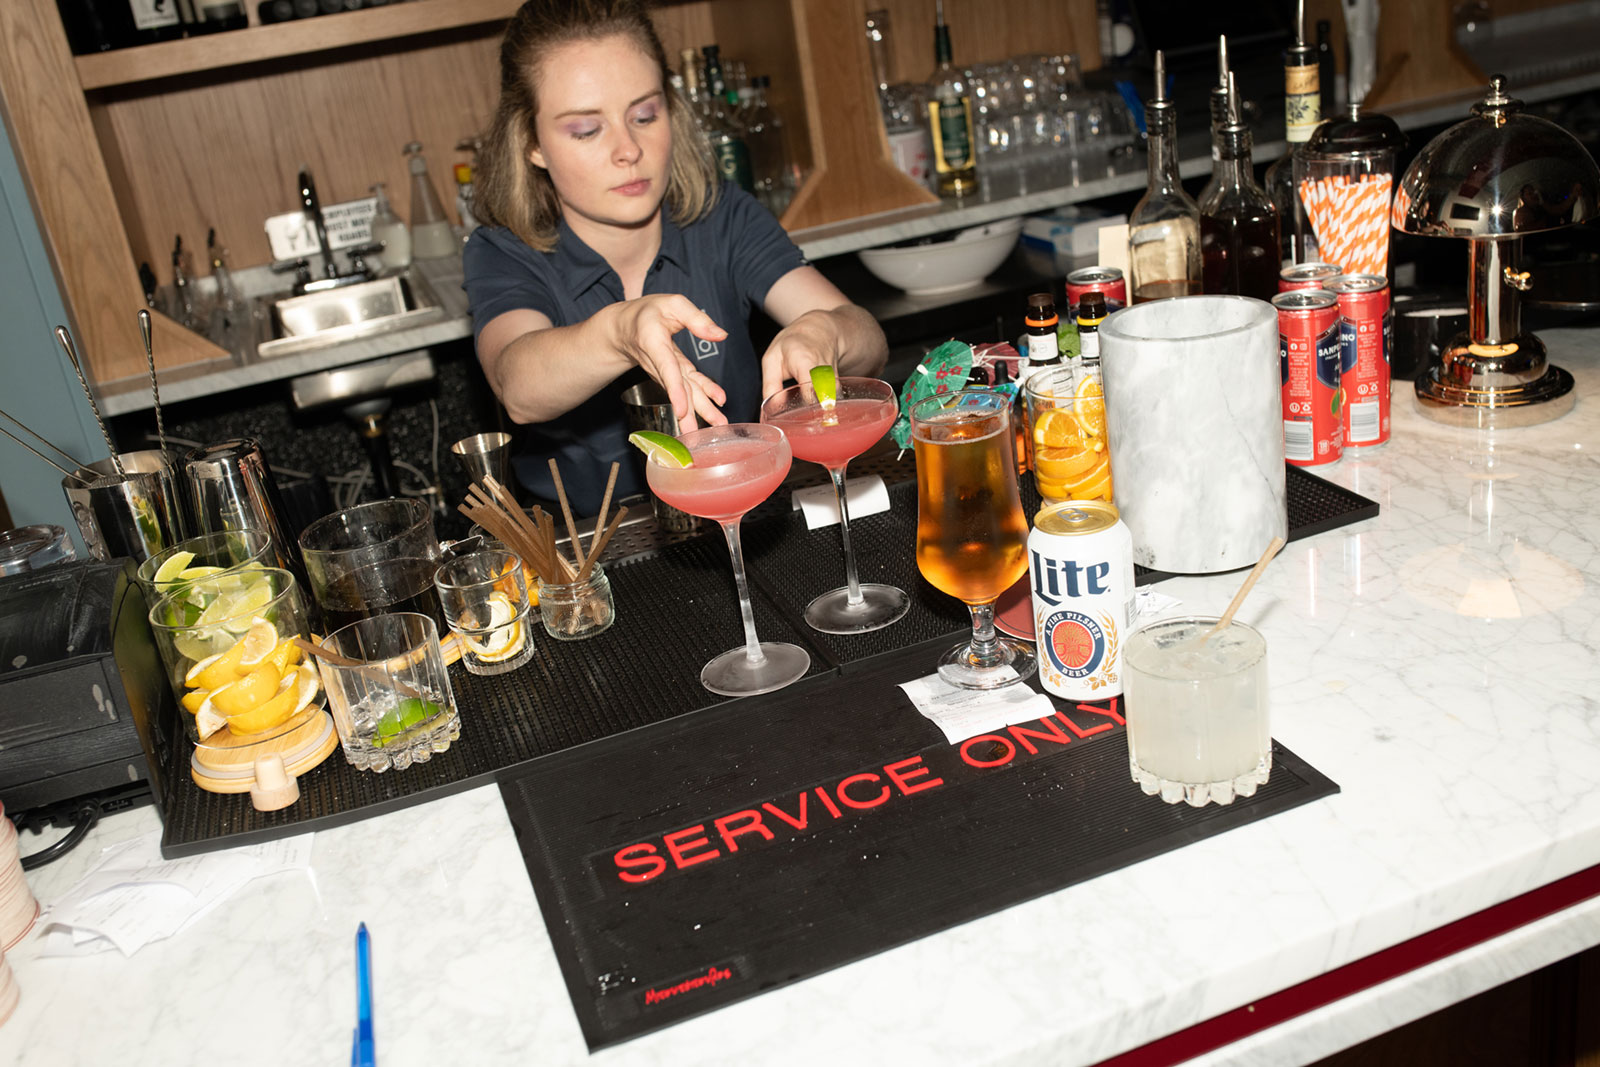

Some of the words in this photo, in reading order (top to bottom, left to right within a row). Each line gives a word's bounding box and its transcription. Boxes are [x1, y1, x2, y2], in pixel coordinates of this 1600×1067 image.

[1047, 612, 1064, 629] FINE
[1066, 612, 1101, 640] PILSNER
[1045, 629, 1052, 637] A
[1061, 667, 1090, 678] BEER
[614, 756, 944, 883] SERVICE
[959, 697, 1127, 768] ONLY
